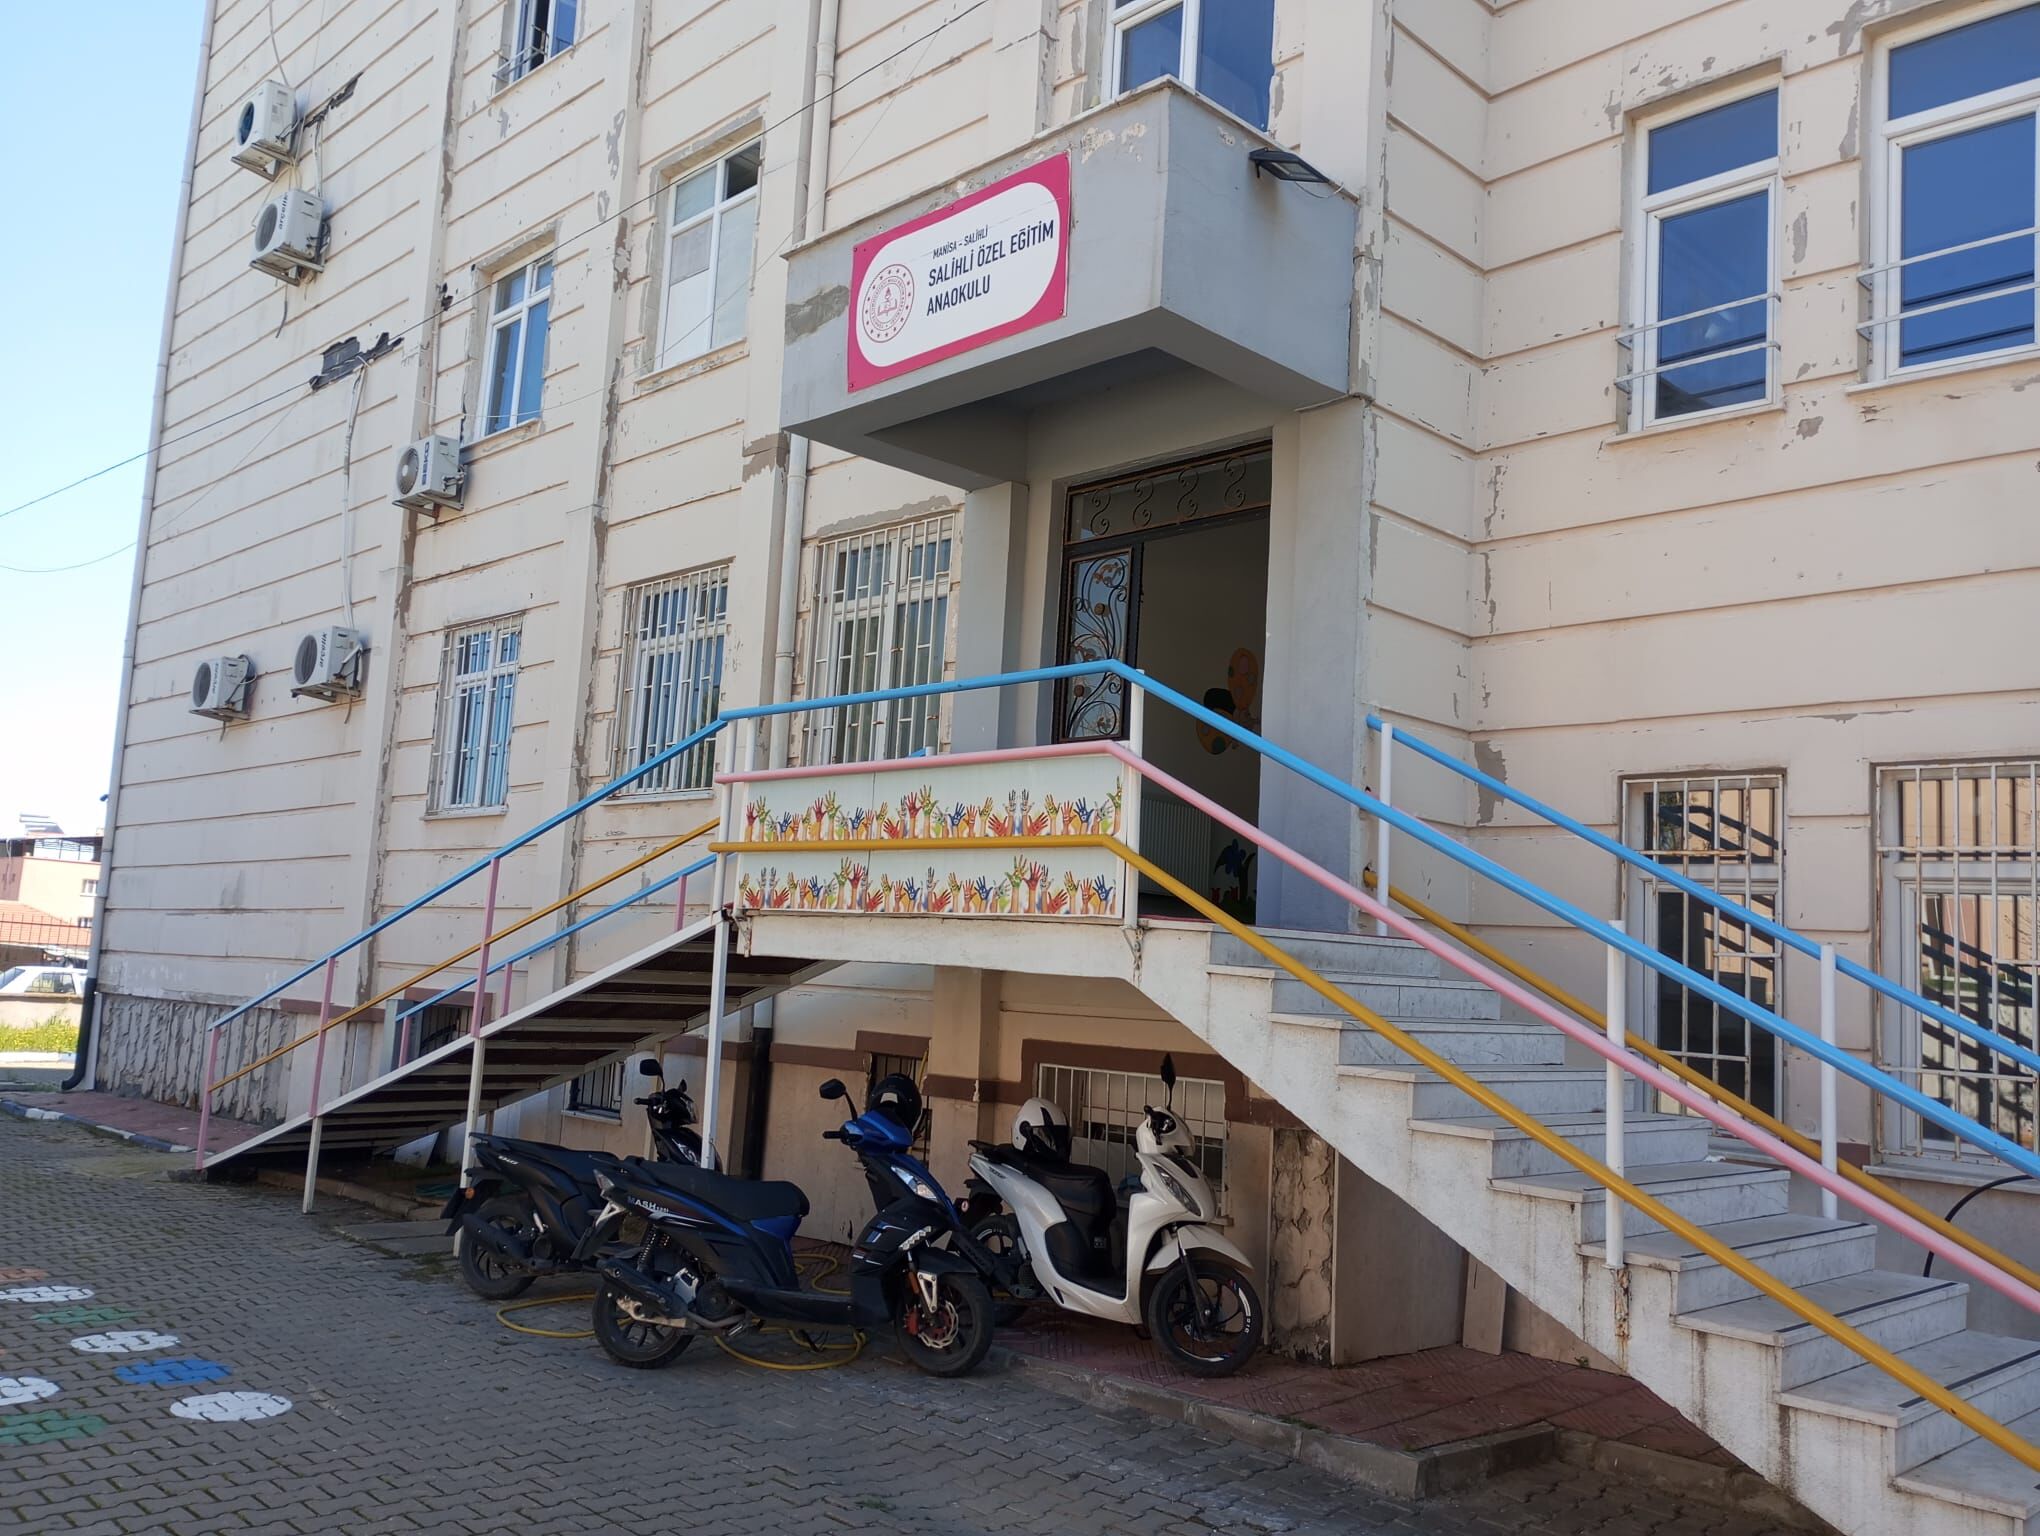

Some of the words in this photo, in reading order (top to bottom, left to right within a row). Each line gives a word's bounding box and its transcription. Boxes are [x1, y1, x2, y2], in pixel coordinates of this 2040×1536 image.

[928, 249, 974, 287] SALİHLİ
[977, 240, 1006, 268] ÖZEL
[1010, 219, 1054, 254] EĞİTİM
[932, 241, 957, 260] MANİSA
[963, 224, 988, 247] SALİHLİ
[926, 274, 991, 317] ANAOKULU
